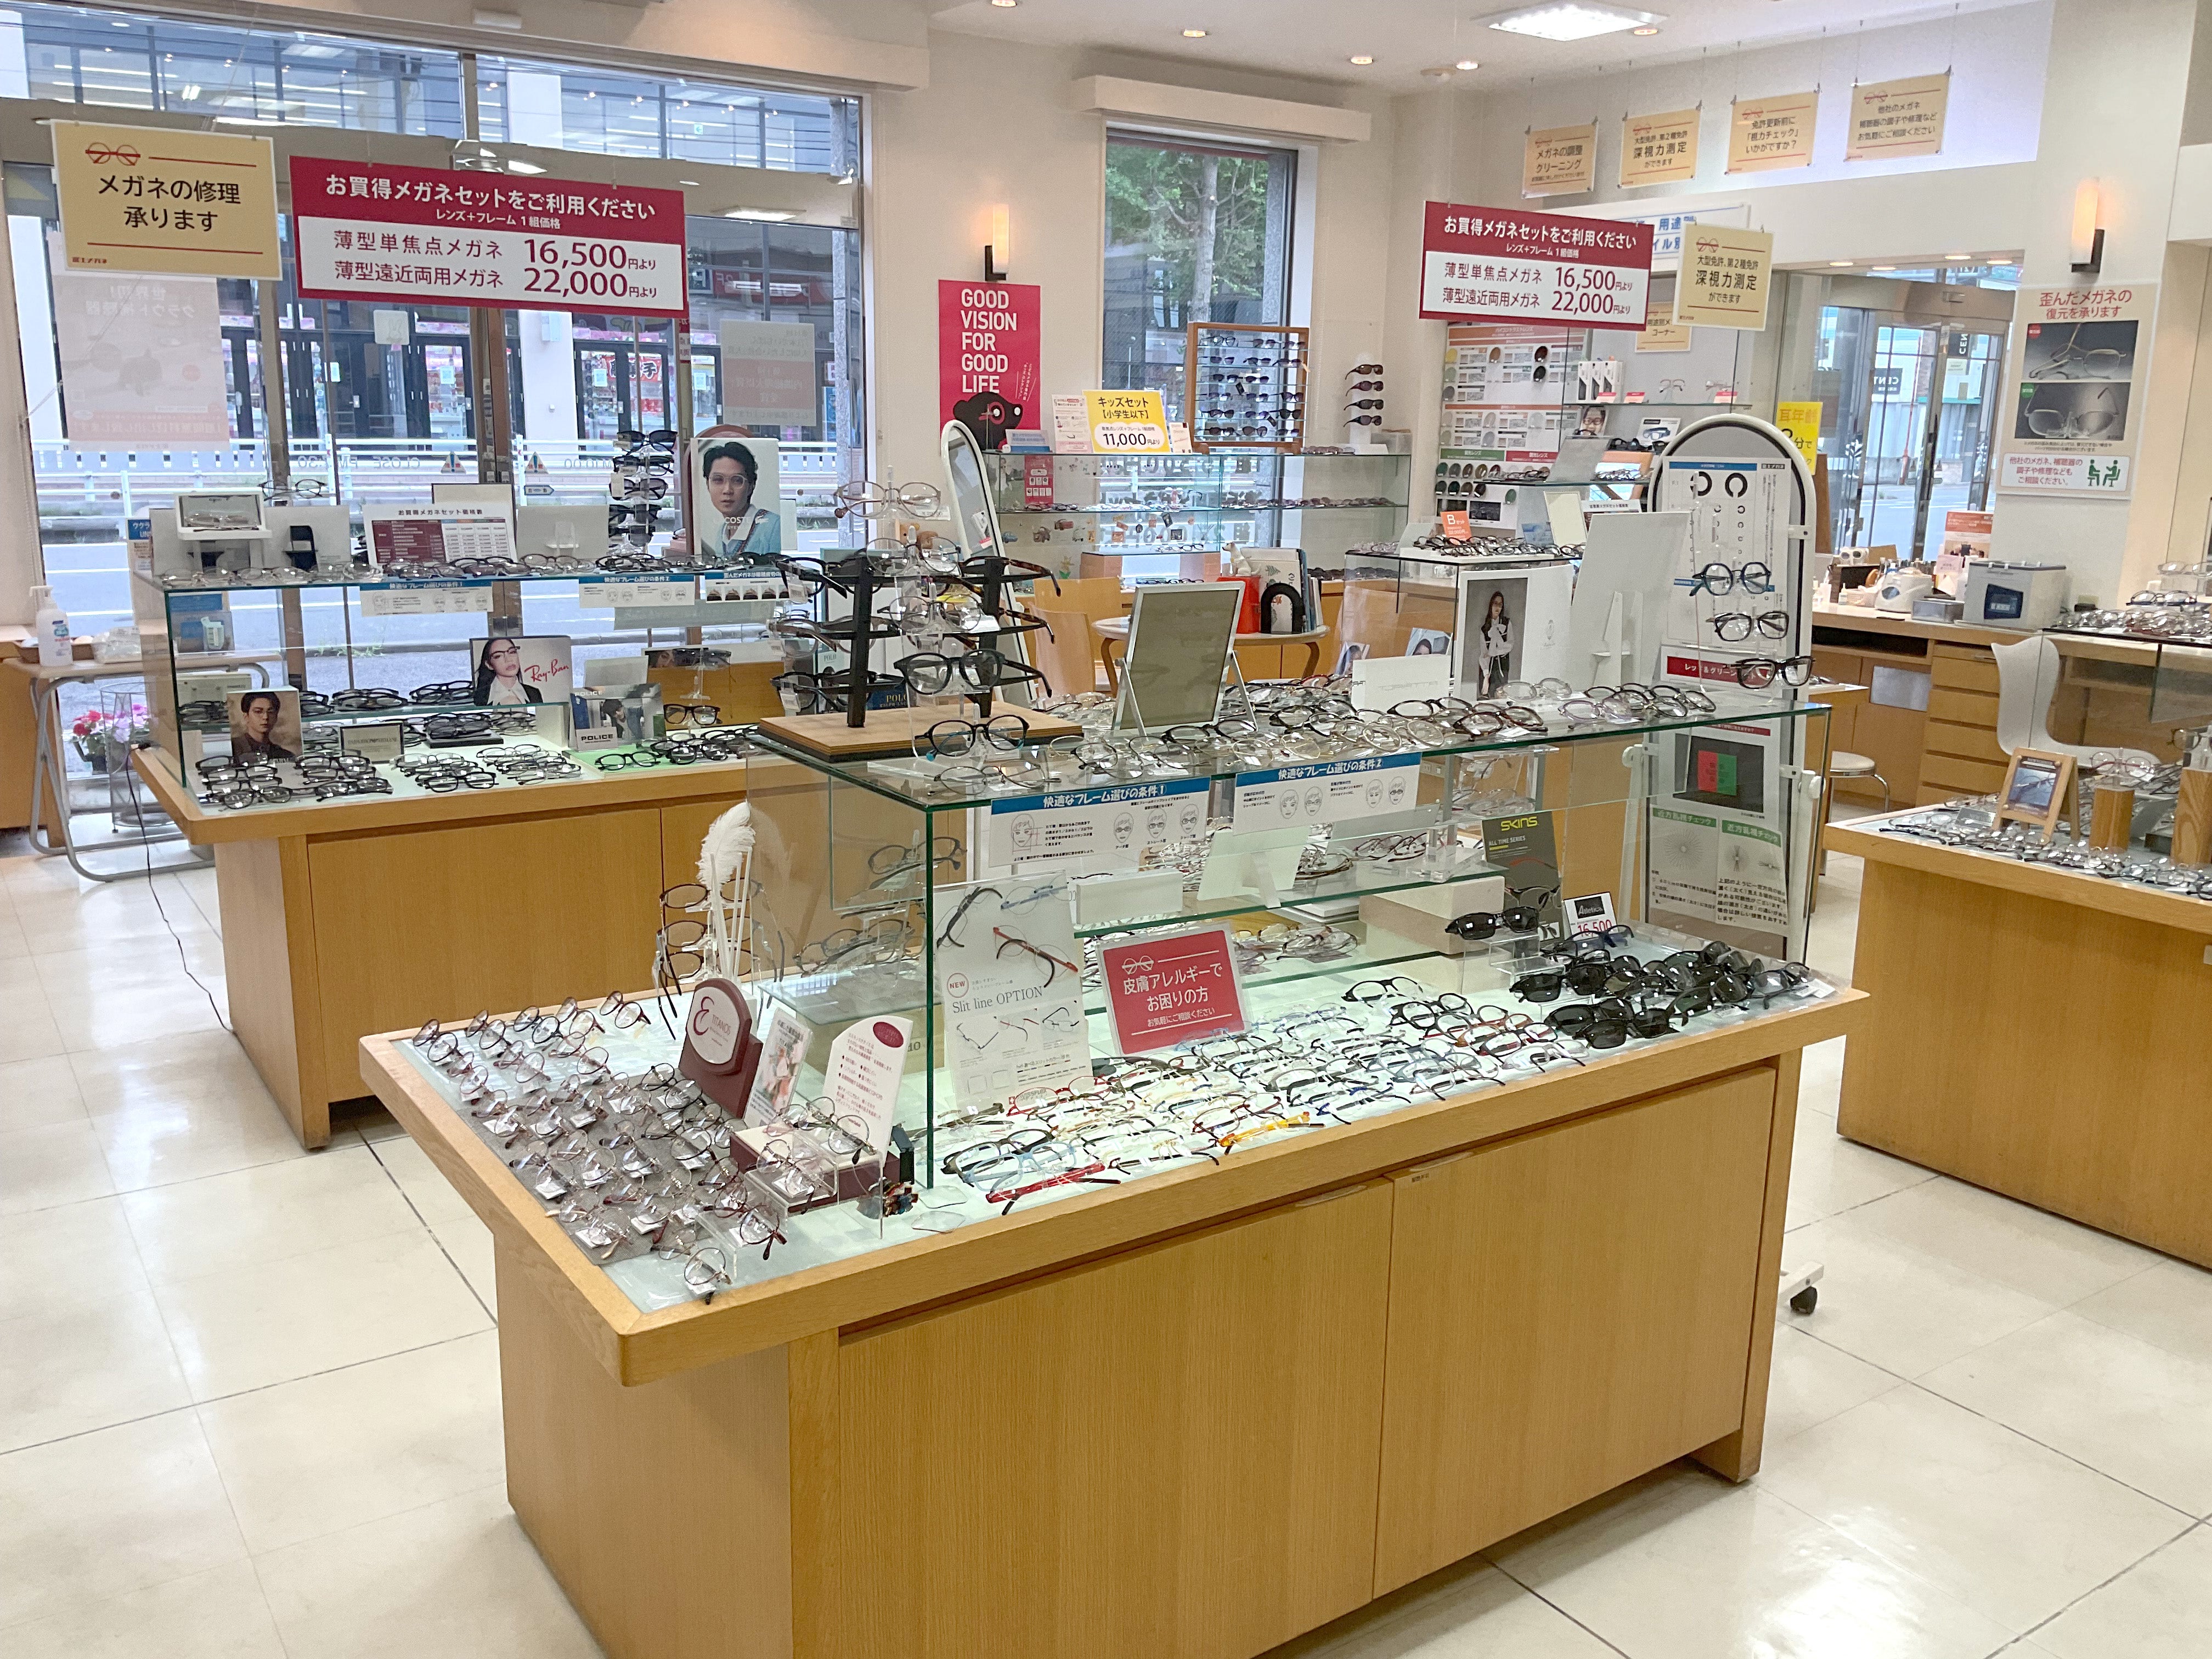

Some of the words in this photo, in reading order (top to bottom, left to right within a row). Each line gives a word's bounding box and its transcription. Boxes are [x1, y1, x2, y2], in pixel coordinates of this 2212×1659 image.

[1536, 159, 1582, 173] クリーニング
[98, 175, 241, 205] メガネの修理
[326, 174, 655, 219] お買得メガネセットをご利用ください
[123, 206, 218, 232] 承ります
[1444, 216, 1637, 250] お買得メガネセットをご利用ください
[334, 230, 502, 259] 薄型単焦点メガネ
[335, 260, 504, 288] 薄型遠近両用メガネ
[1444, 262, 1542, 284] 薄型単焦点メガネ
[1695, 269, 1757, 290] 深視力測定
[961, 289, 1009, 309] GOOD
[1443, 287, 1540, 308] 薄型遠近両用メガネ
[1708, 292, 1741, 304] ができます
[2039, 290, 2132, 307] 歪んだメガネの
[961, 310, 1017, 331] VISION
[2046, 306, 2121, 320] 復元を承ります
[962, 332, 996, 351] FOR
[961, 353, 1008, 373] GOOD
[962, 375, 1000, 393] LIFE
[1098, 397, 1149, 408] キッズセット
[524, 659, 569, 682] Ray-Ban
[950, 980, 966, 989] NEW
[1123, 962, 1223, 995] 皮膚アレルギーで
[952, 1001, 970, 1013] Slit
[974, 997, 992, 1009] line
[997, 986, 1042, 1005] OPTION
[1147, 987, 1209, 1013] お困りの方
[711, 1014, 731, 1035] TITANOS
[1147, 1007, 1216, 1028] お気軽にご相談ください
